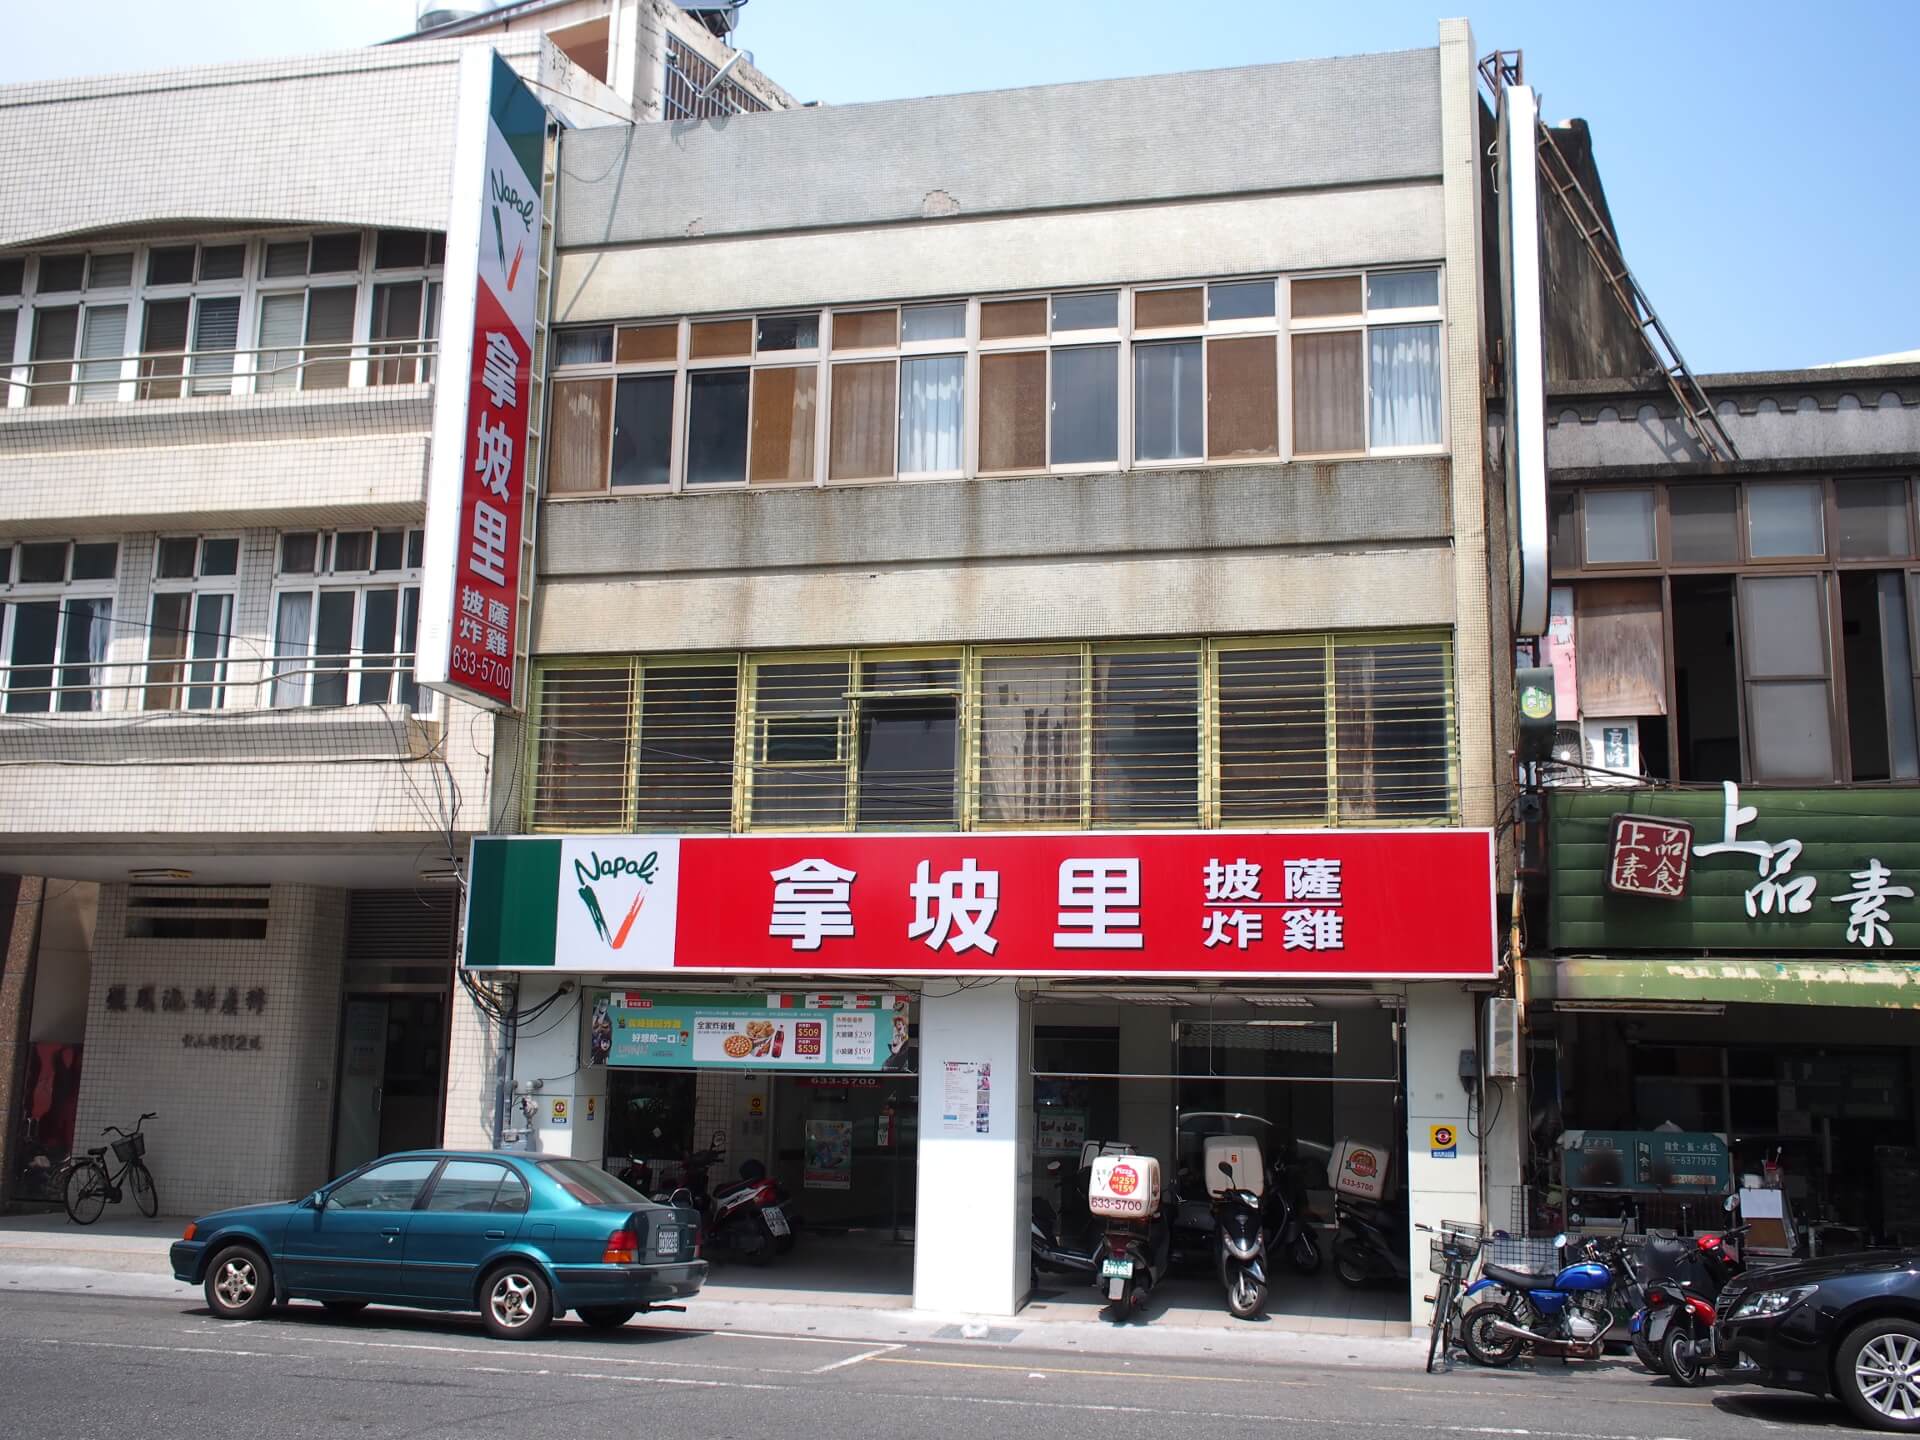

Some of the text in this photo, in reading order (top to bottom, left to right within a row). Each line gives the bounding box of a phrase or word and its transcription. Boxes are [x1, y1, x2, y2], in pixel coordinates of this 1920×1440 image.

[491, 168, 534, 233] Napoli
[470, 330, 520, 587] 拿坡里
[462, 585, 510, 629] 披薩
[459, 616, 508, 658] 炸雞
[452, 644, 511, 690] 633-5700
[1617, 824, 1684, 857] 上品
[574, 849, 660, 885] Napoli
[1202, 858, 1343, 901] 披薩
[1617, 855, 1684, 892] 素食
[1692, 780, 1915, 948] 上品素
[769, 857, 1144, 955] 拿坡里
[1201, 908, 1344, 951] 炸雞
[797, 1044, 819, 1053] $539
[798, 1028, 819, 1037] $509
[1119, 1177, 1136, 1185] 259
[1091, 1198, 1142, 1211] 633-5700
